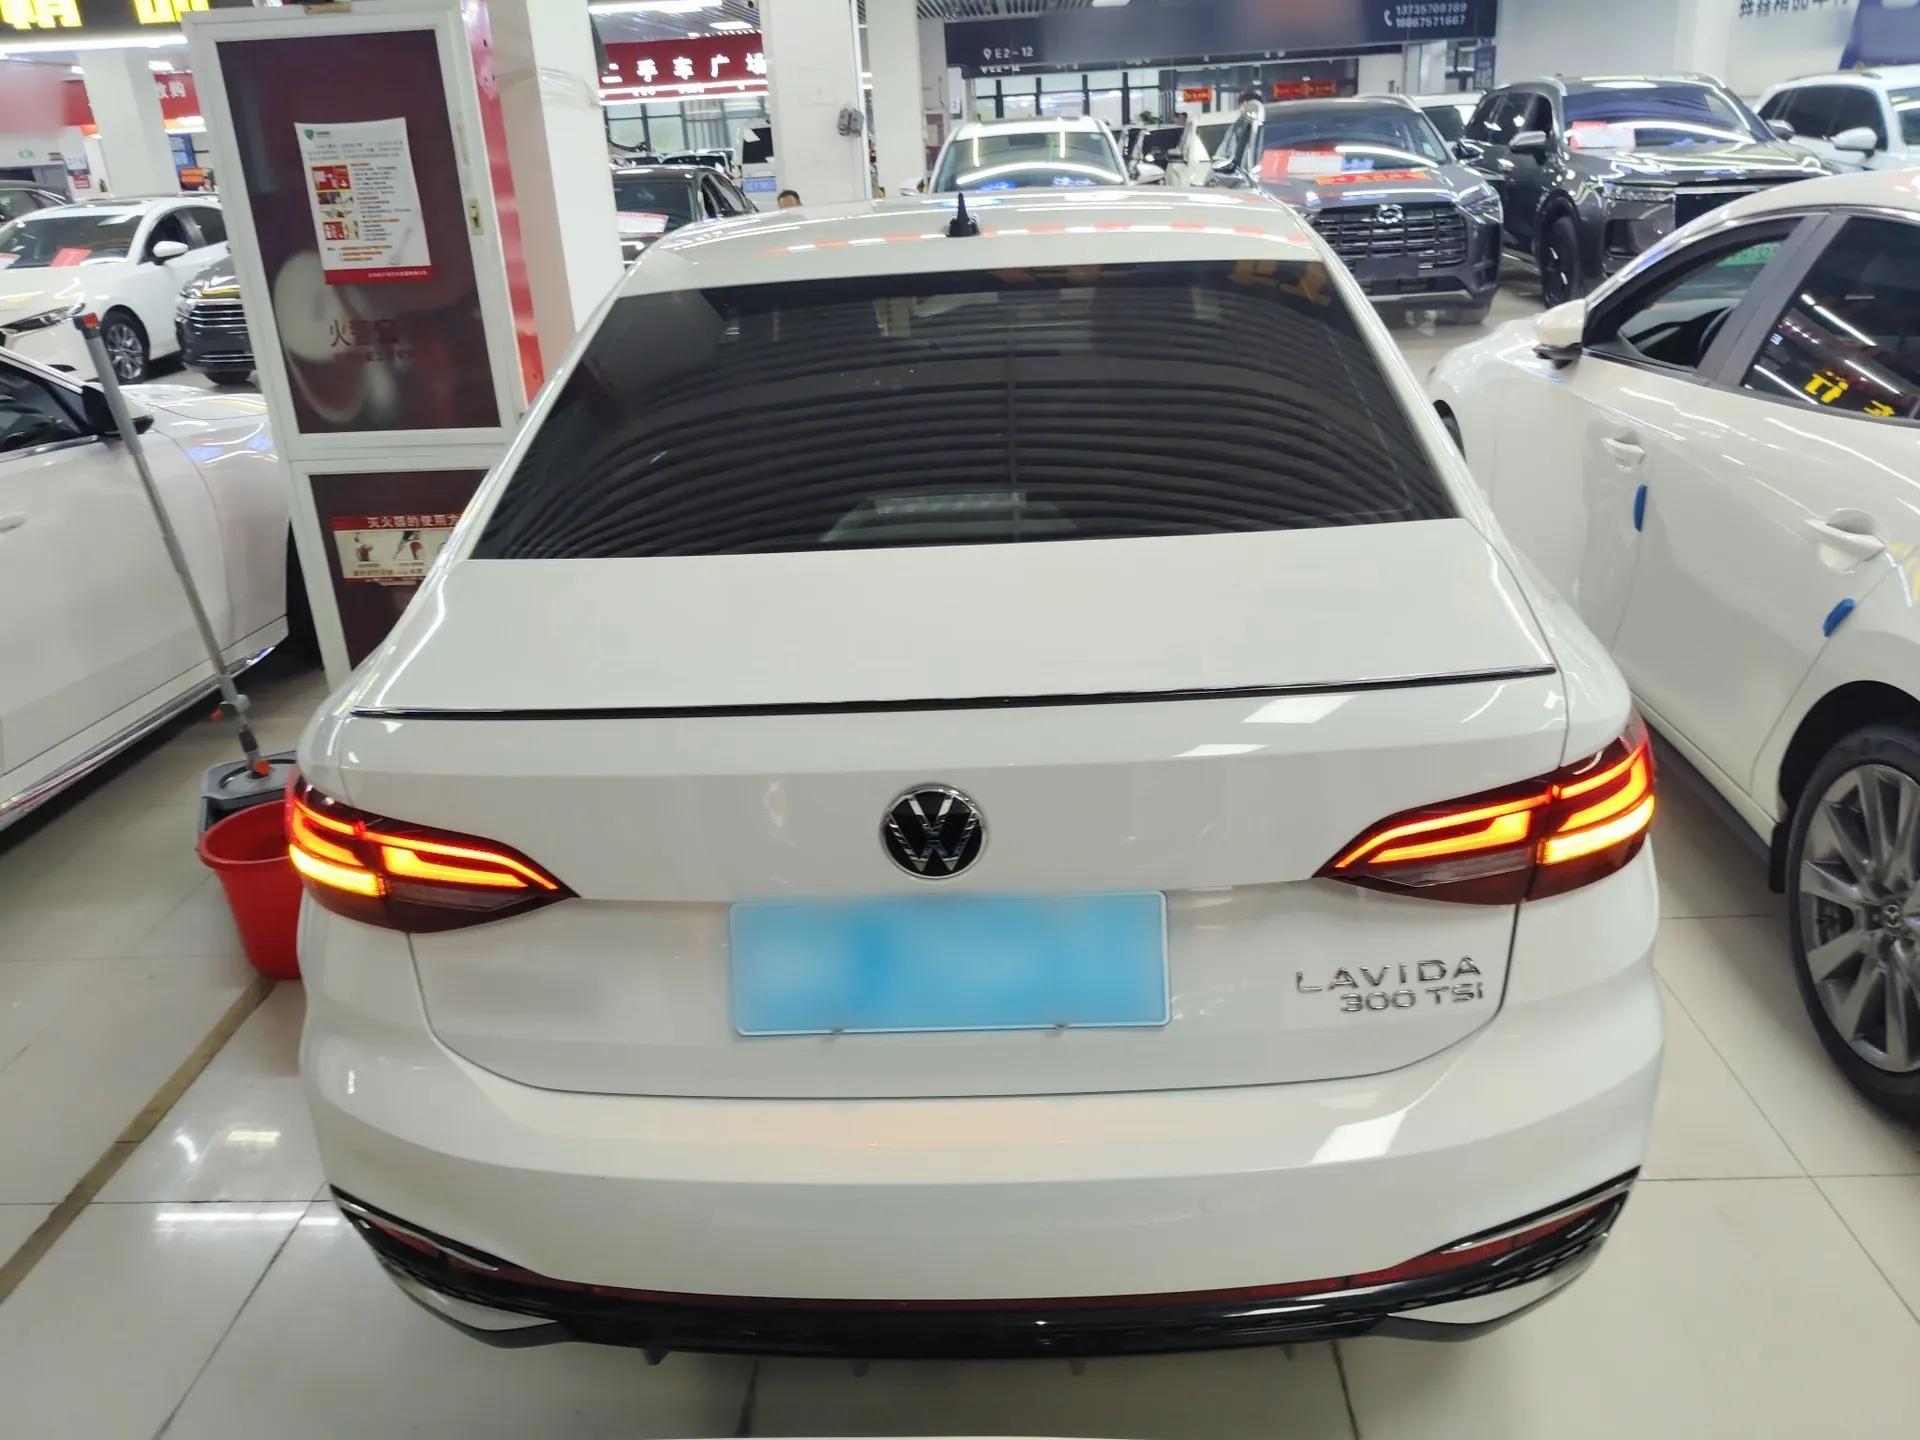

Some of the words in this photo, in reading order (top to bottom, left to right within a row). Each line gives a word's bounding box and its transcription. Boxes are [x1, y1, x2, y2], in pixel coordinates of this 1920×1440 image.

[602, 52, 767, 83] 二手车广场
[1296, 954, 1481, 993] LAVIDA
[1340, 990, 1416, 1012] 300
